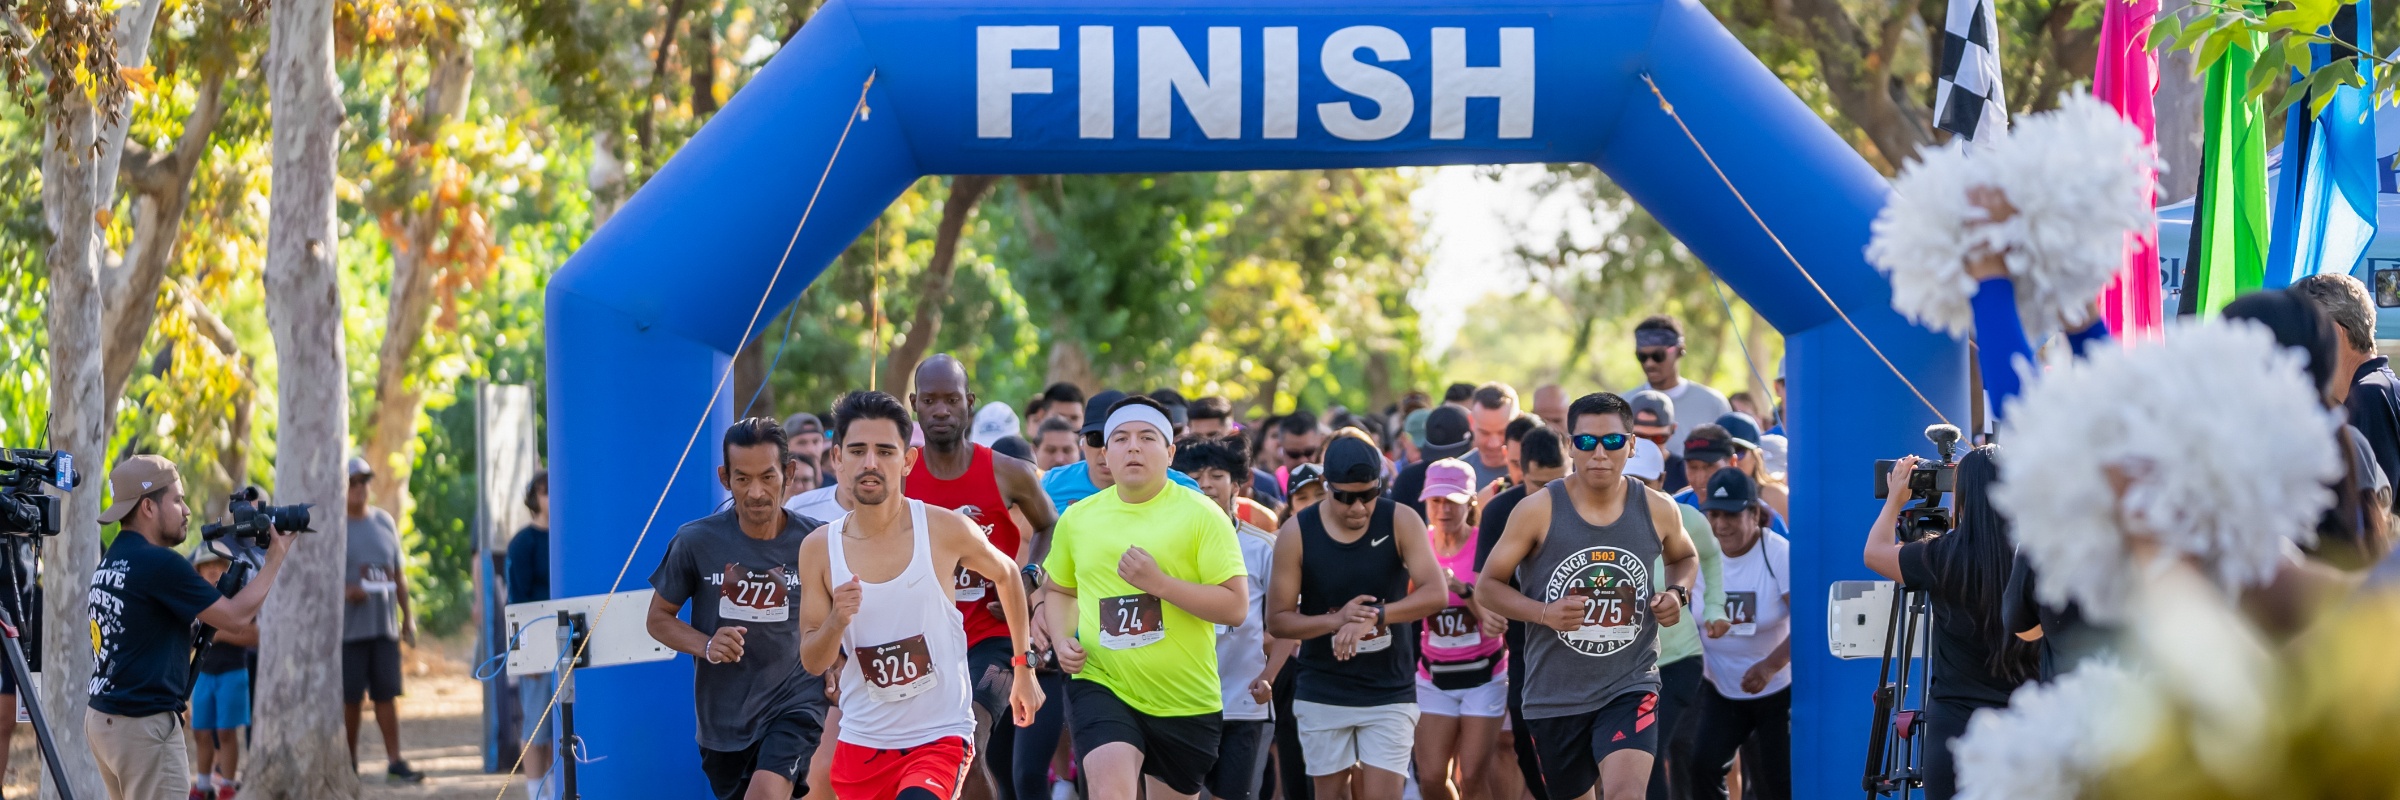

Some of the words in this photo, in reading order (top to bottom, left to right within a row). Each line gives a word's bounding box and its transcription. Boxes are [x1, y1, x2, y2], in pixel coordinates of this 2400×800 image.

[976, 25, 1535, 141] FINISH
[1591, 551, 1616, 561] 1503
[1549, 553, 1588, 600] ORANGE
[1619, 554, 1646, 600] COUNTY
[736, 580, 777, 606] 272
[1117, 606, 1143, 633] 24
[1436, 613, 1467, 635] 194
[1583, 599, 1623, 624] 275
[872, 651, 918, 685] 326
